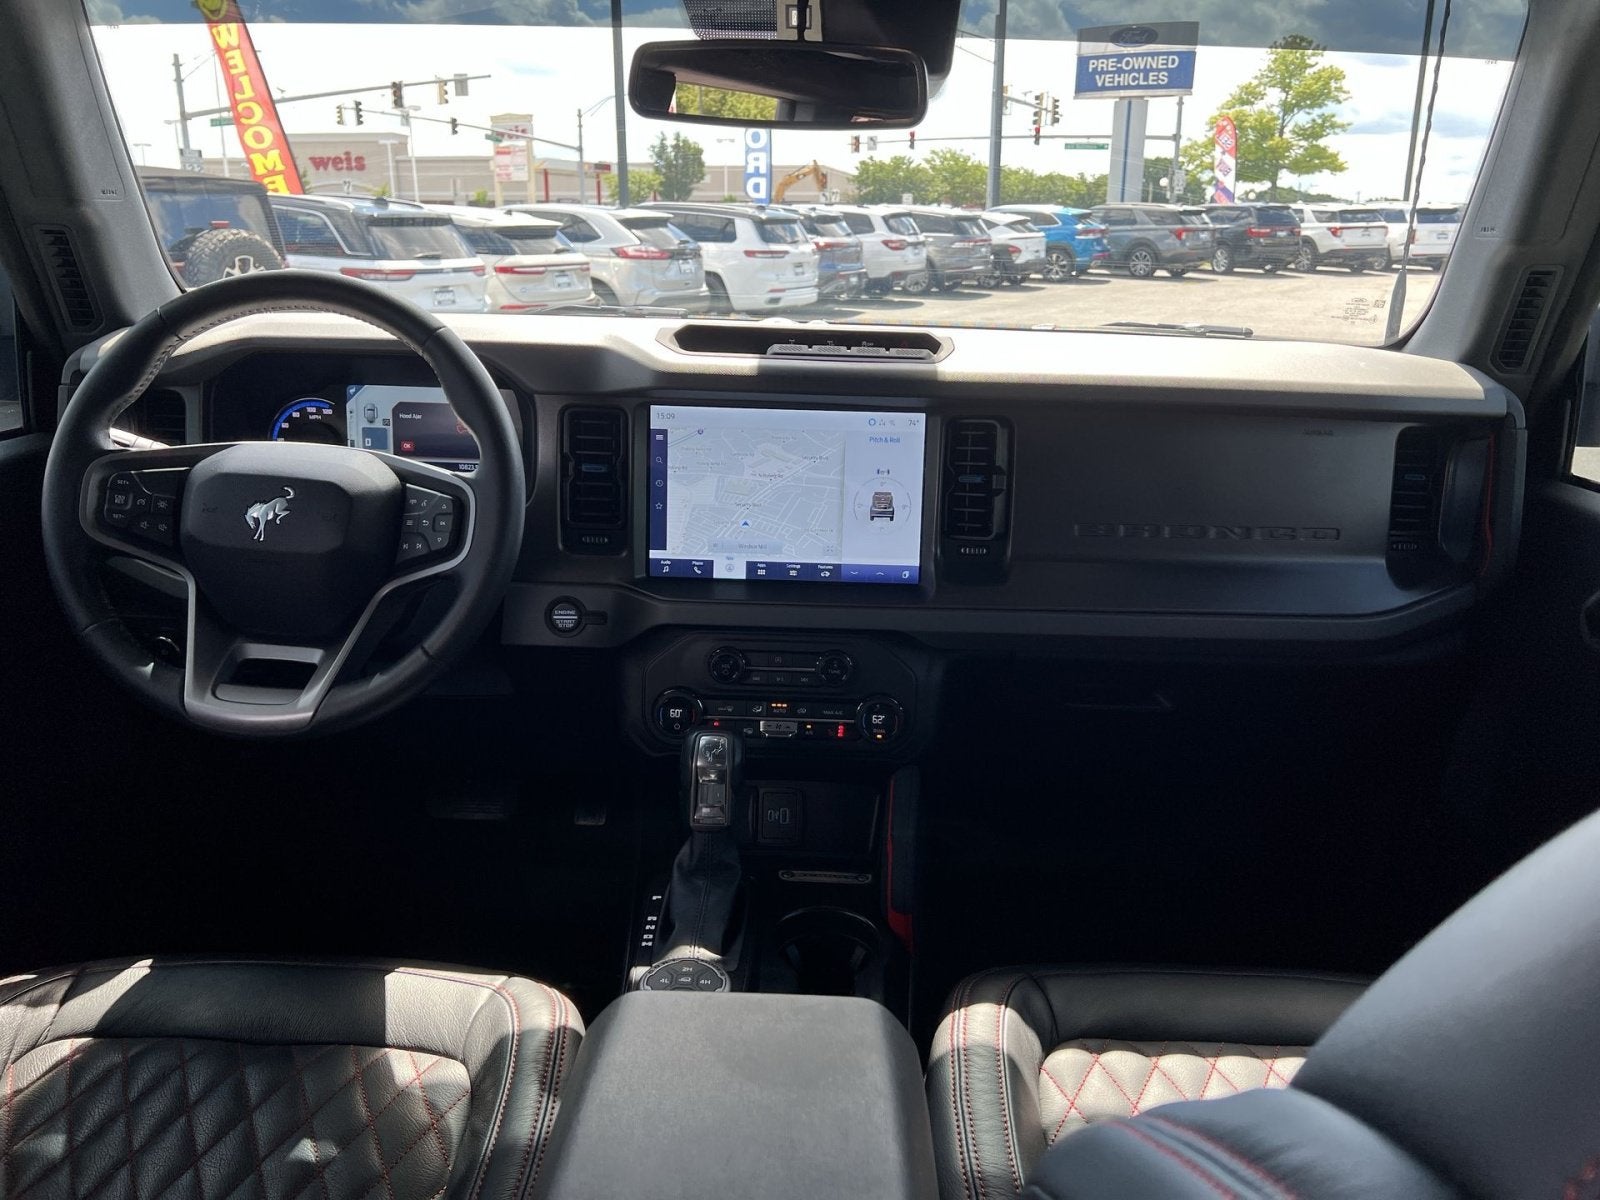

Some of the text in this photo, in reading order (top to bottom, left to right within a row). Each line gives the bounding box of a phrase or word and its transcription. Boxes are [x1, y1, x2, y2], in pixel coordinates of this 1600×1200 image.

[1088, 55, 1180, 72] PRE-OWNED
[1095, 72, 1169, 87] VEHICLES
[308, 150, 367, 172] weis
[656, 412, 676, 420] 15:09
[869, 435, 883, 443] Pitch
[890, 436, 901, 444] Roll
